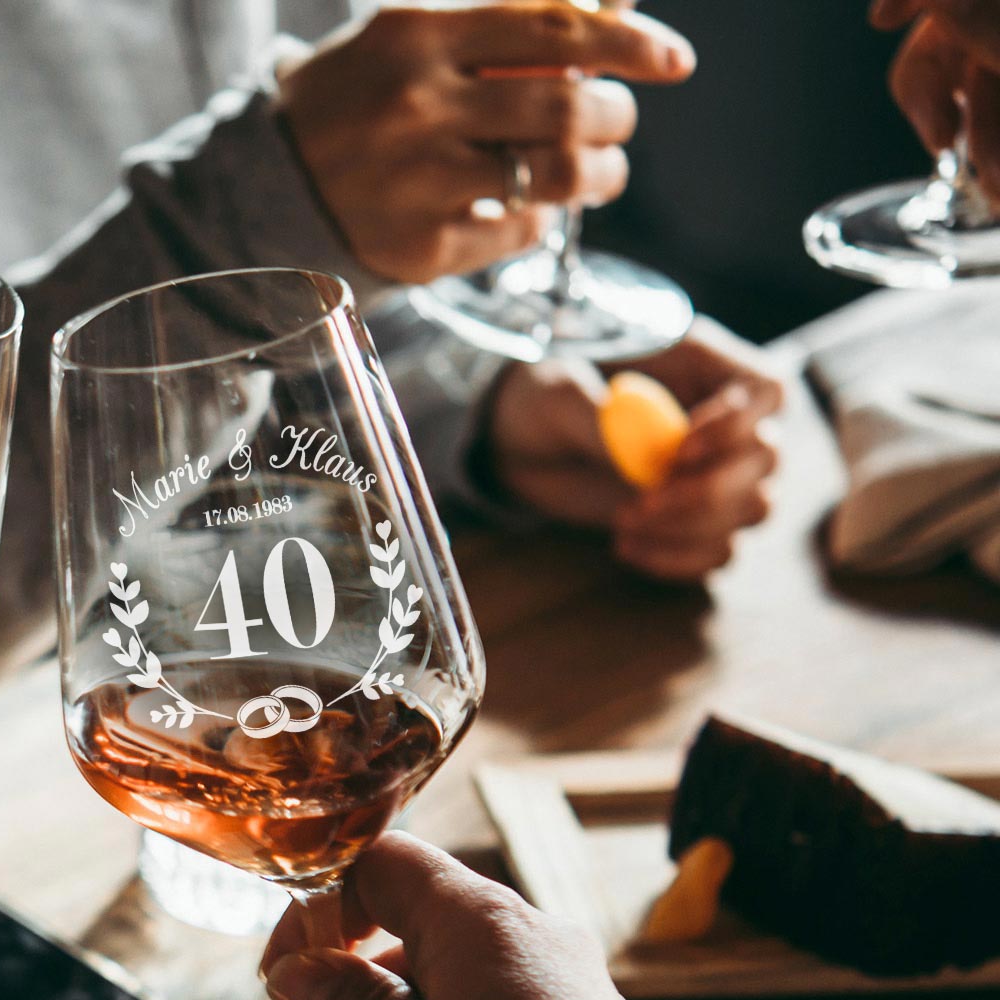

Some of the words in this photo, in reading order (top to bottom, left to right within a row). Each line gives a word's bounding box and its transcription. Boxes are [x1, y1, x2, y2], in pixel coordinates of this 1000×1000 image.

[112, 454, 212, 537] Marie
[228, 428, 252, 481] &
[269, 425, 378, 493] Klaus
[203, 495, 293, 528] 17.08.1983
[194, 537, 336, 660] 40
